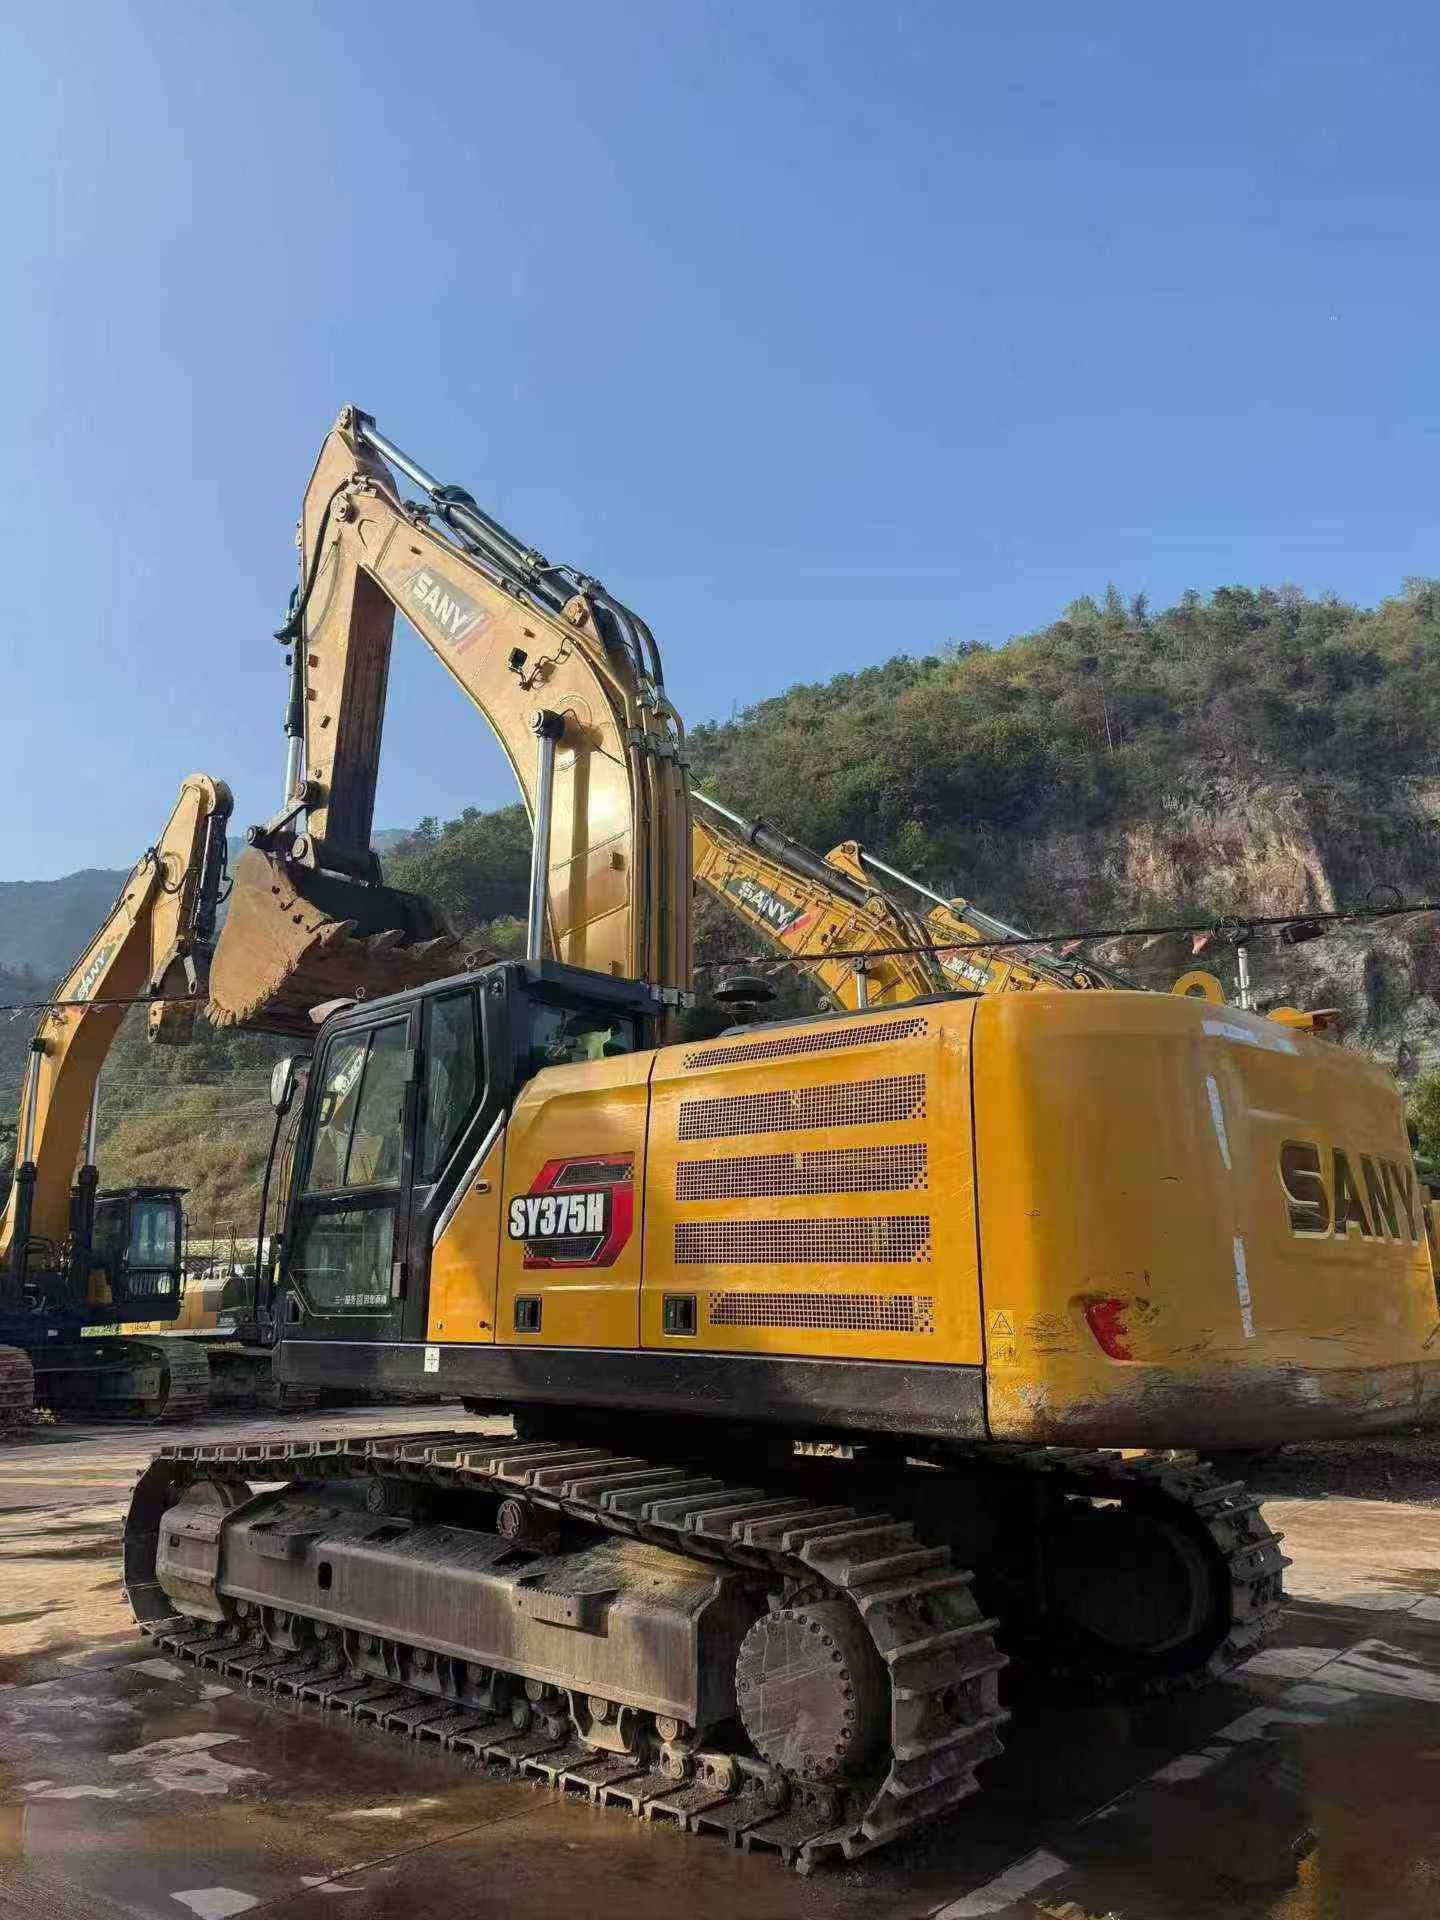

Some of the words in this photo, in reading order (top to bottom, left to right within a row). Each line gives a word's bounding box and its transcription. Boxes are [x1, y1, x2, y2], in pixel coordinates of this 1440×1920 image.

[413, 571, 471, 634] SANY
[738, 879, 792, 923] SANY
[510, 1192, 604, 1237] SY375H
[1279, 1138, 1419, 1246] SANY
